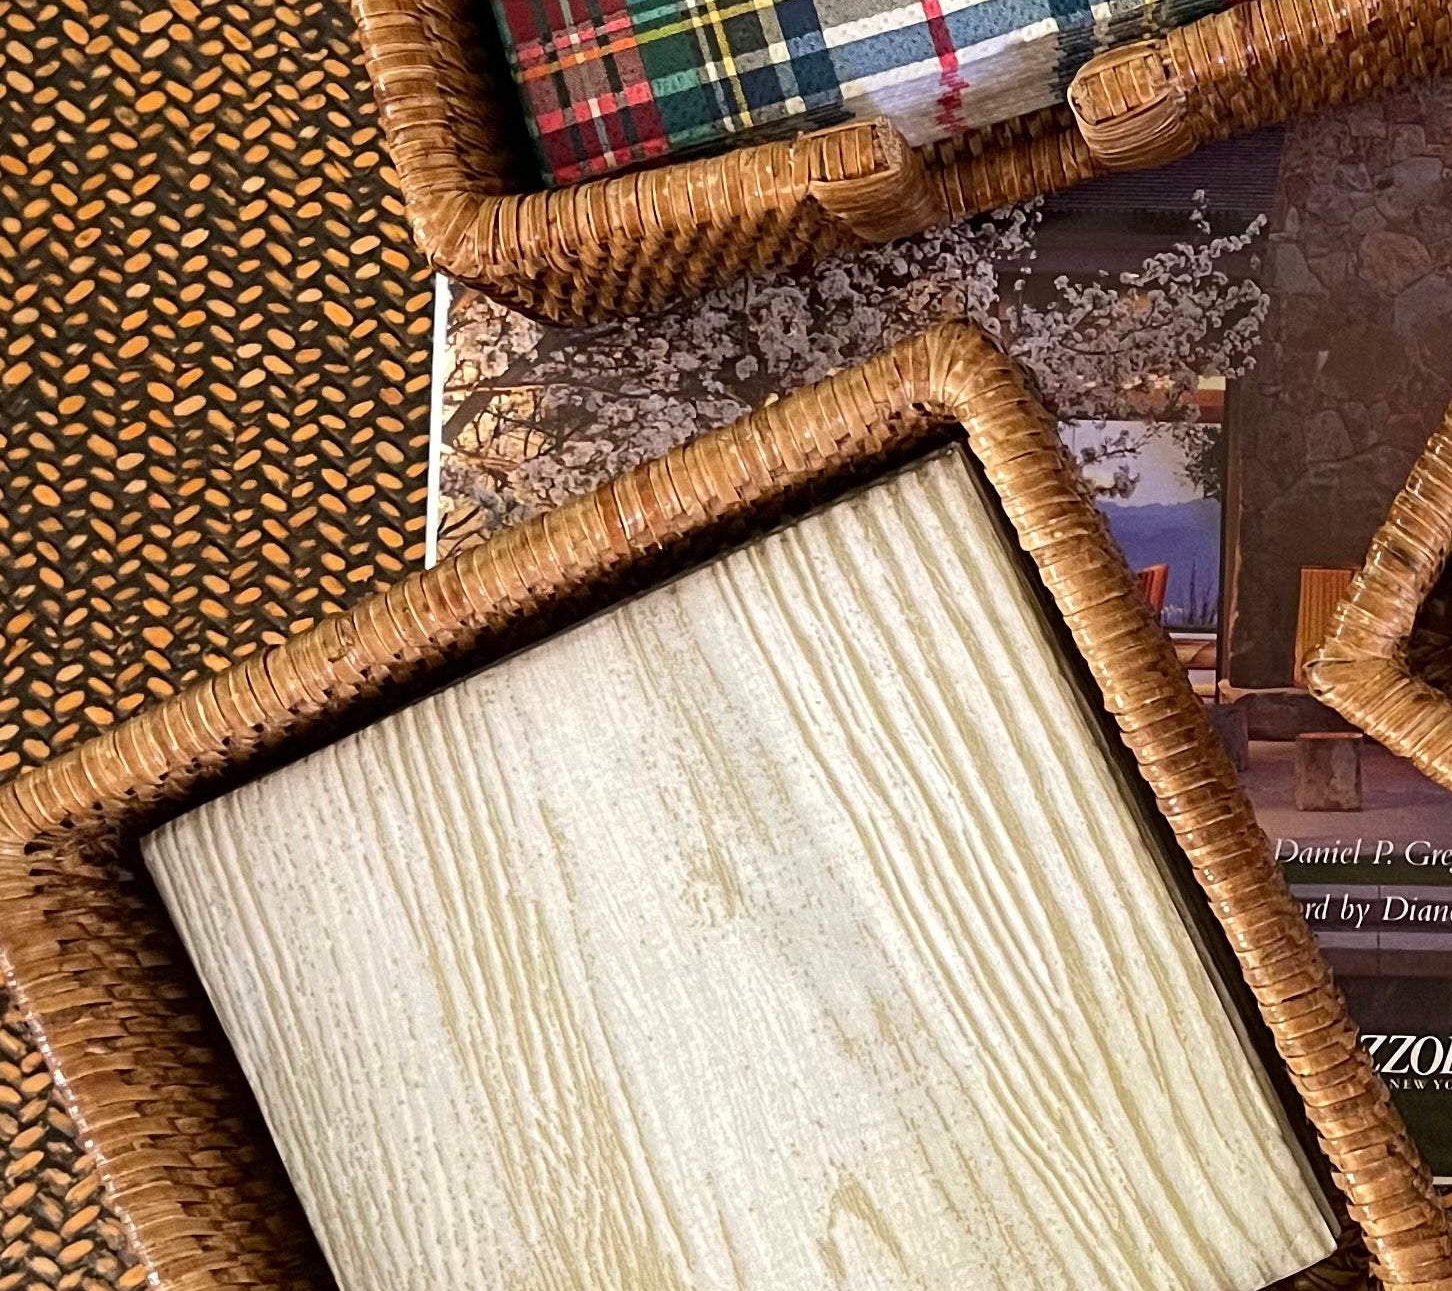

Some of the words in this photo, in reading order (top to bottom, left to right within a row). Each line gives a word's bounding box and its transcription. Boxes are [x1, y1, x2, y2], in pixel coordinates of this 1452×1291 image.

[1273, 838, 1363, 865] Daniel
[1372, 840, 1395, 866] P.
[1340, 894, 1371, 929] by
[1389, 1078, 1428, 1091] NEW
